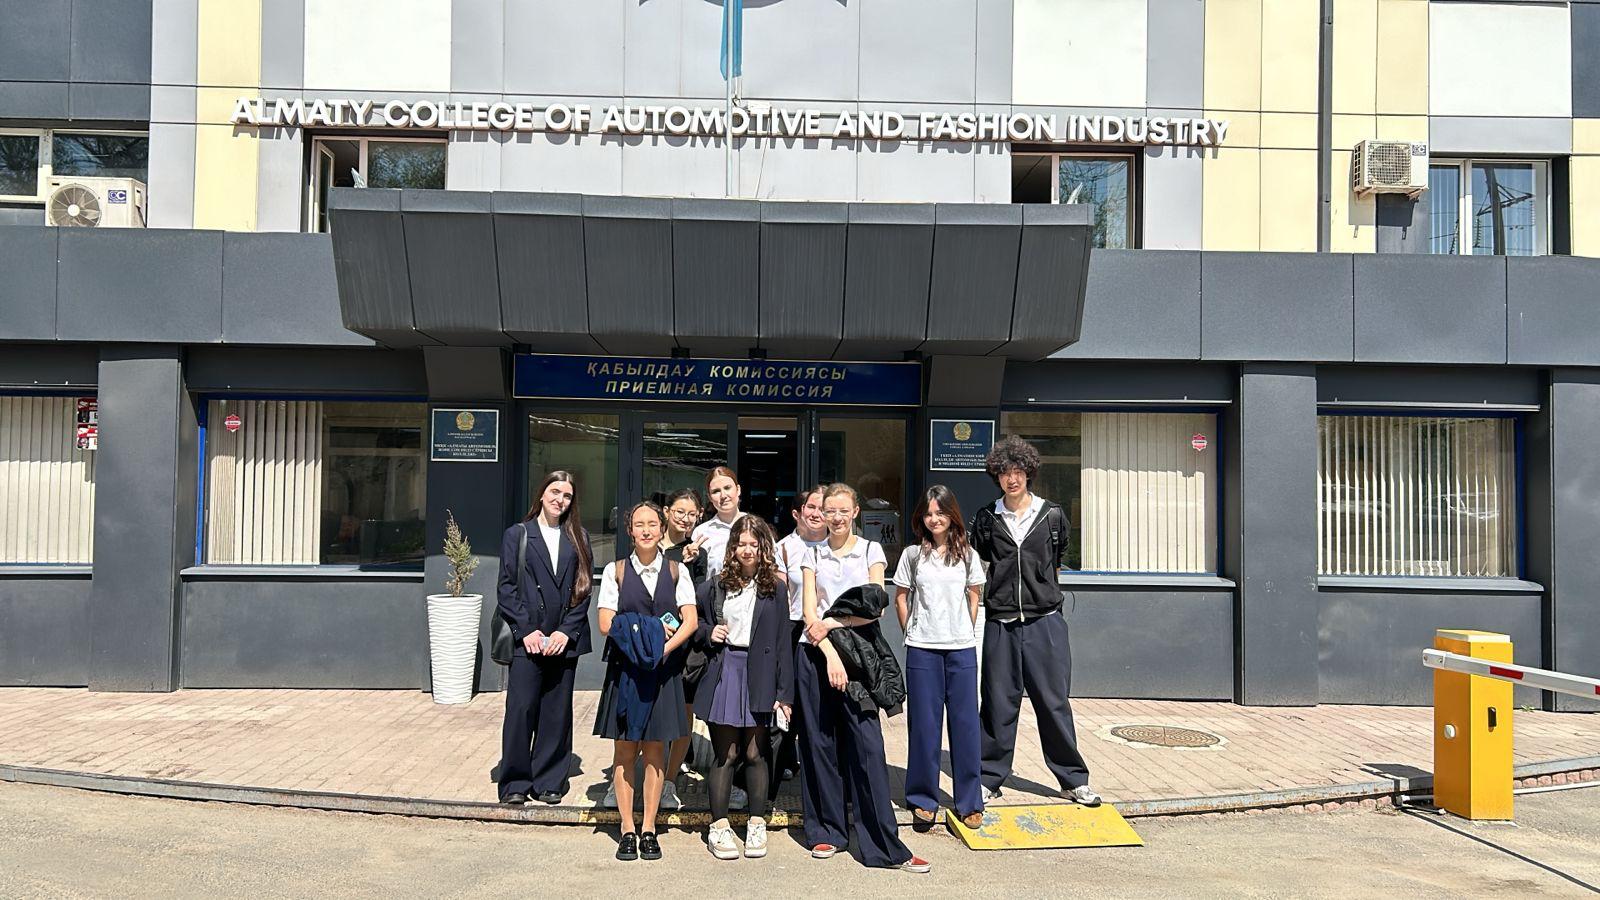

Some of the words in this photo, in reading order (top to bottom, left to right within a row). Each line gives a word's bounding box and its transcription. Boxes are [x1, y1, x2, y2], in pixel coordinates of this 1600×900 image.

[230, 96, 373, 127] ALMATY
[383, 99, 533, 130] COLLEGE
[544, 103, 591, 132] OF
[600, 105, 821, 138] AUTOMOTIVE
[833, 110, 904, 139] AND
[919, 112, 1057, 142] FASHION
[1066, 114, 1232, 146] INDUSTRY
[586, 362, 695, 378] ҚАБЫЛДАУ
[709, 365, 847, 380] КОМИССИЯСЫ
[605, 380, 713, 396] ПРИЕМНАЯ
[726, 383, 833, 398] КОМИССИЯ
